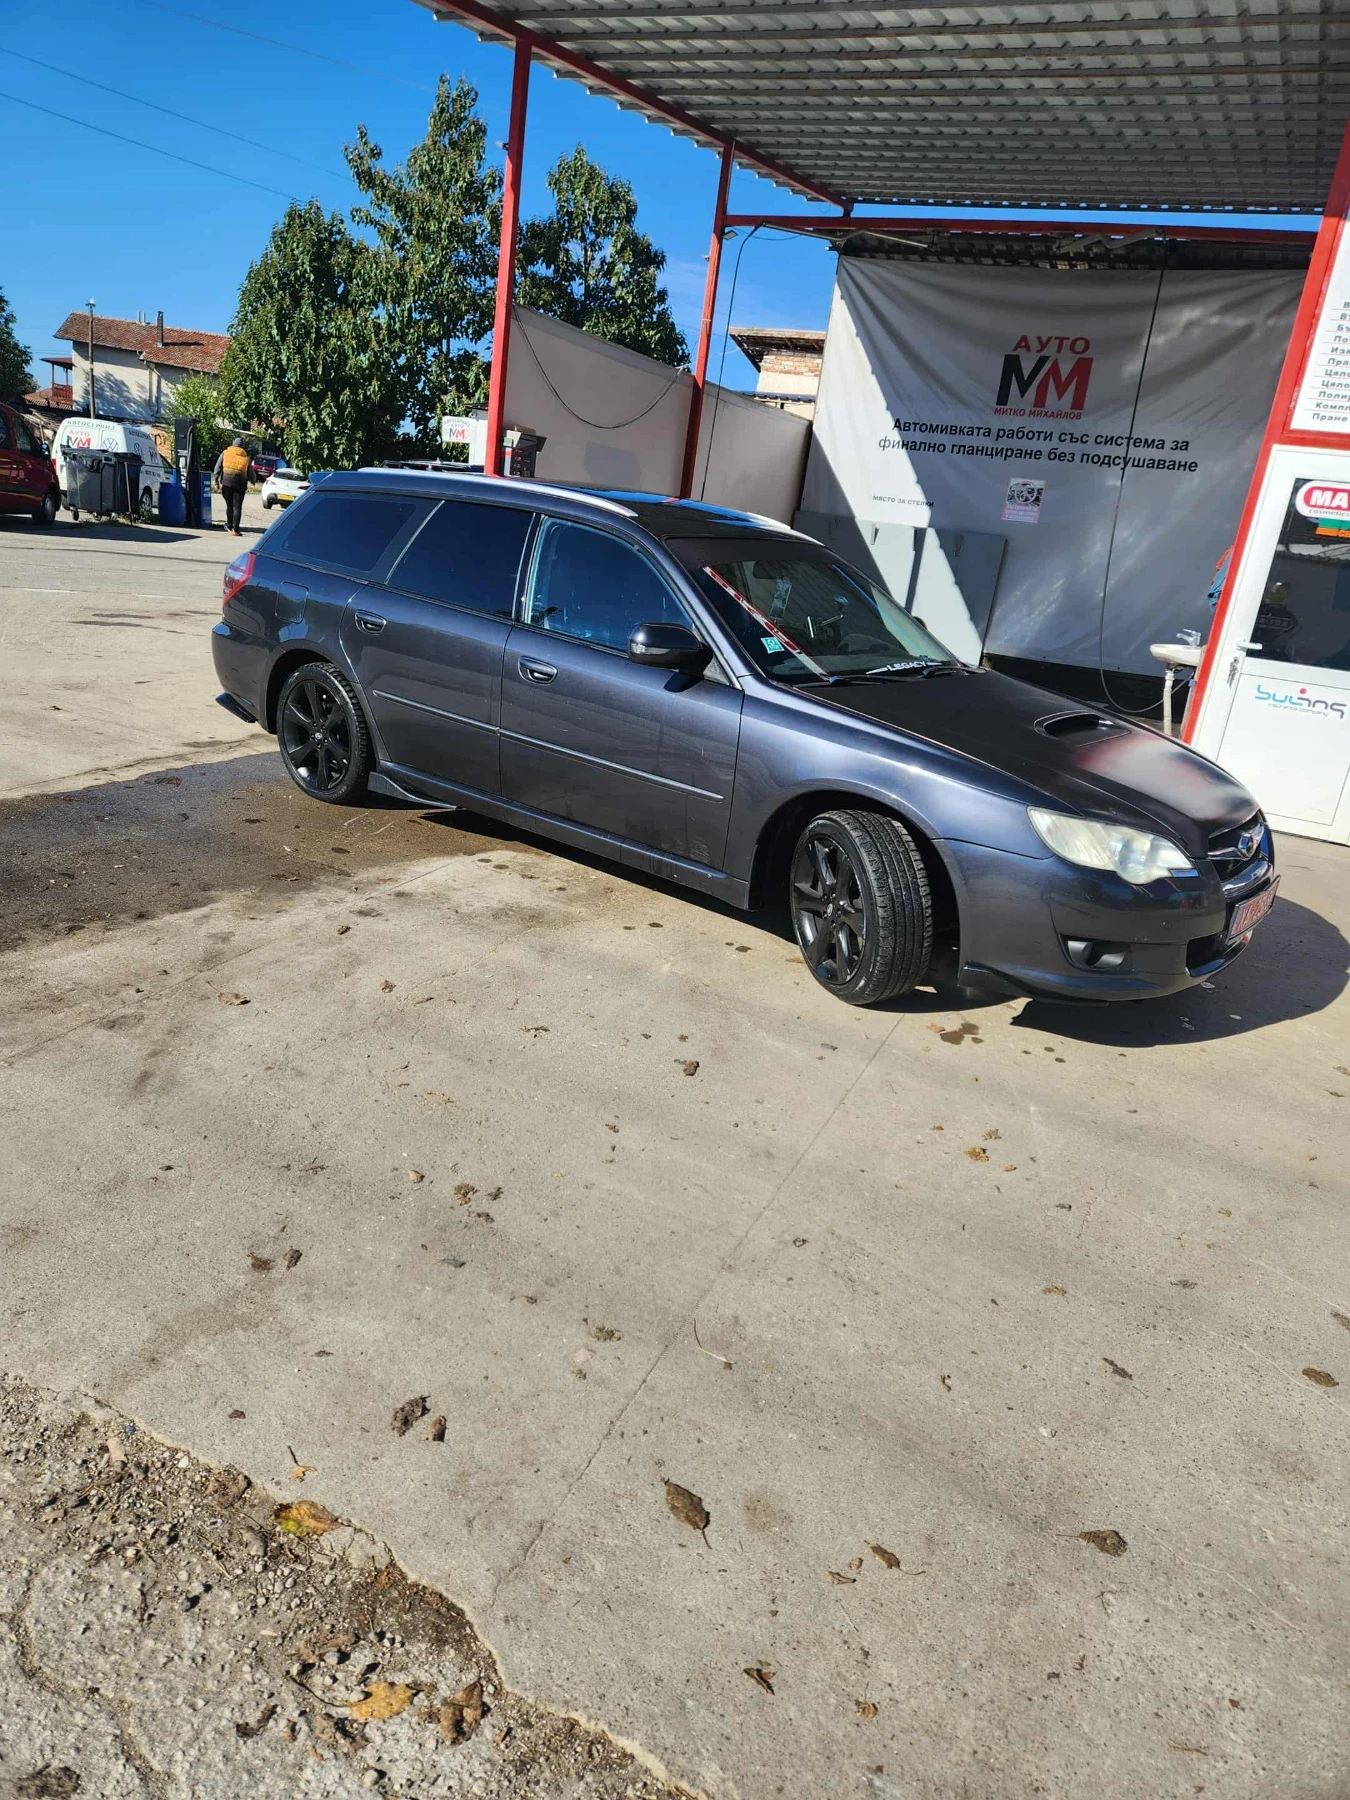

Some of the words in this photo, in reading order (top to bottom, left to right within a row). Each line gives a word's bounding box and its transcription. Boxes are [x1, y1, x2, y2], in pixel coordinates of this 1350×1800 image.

[1340, 312, 1350, 321] В
[1334, 335, 1350, 343] По
[1012, 334, 1091, 355] АУТО
[994, 407, 1026, 417] МИТКО
[1028, 409, 1082, 420] МИХАЙЛОВ
[1312, 412, 1348, 422] Пране
[892, 418, 992, 438] Автомивката
[995, 425, 1053, 442] работи
[1058, 431, 1089, 444] със
[1094, 433, 1166, 450] система
[1170, 439, 1190, 452] за
[878, 435, 947, 454] финално
[950, 443, 1043, 461] гланциране
[1047, 447, 1076, 463] без
[1080, 452, 1199, 473] подсушаване
[872, 495, 896, 503] МЯСТО
[887, 661, 927, 671] LEGACY
